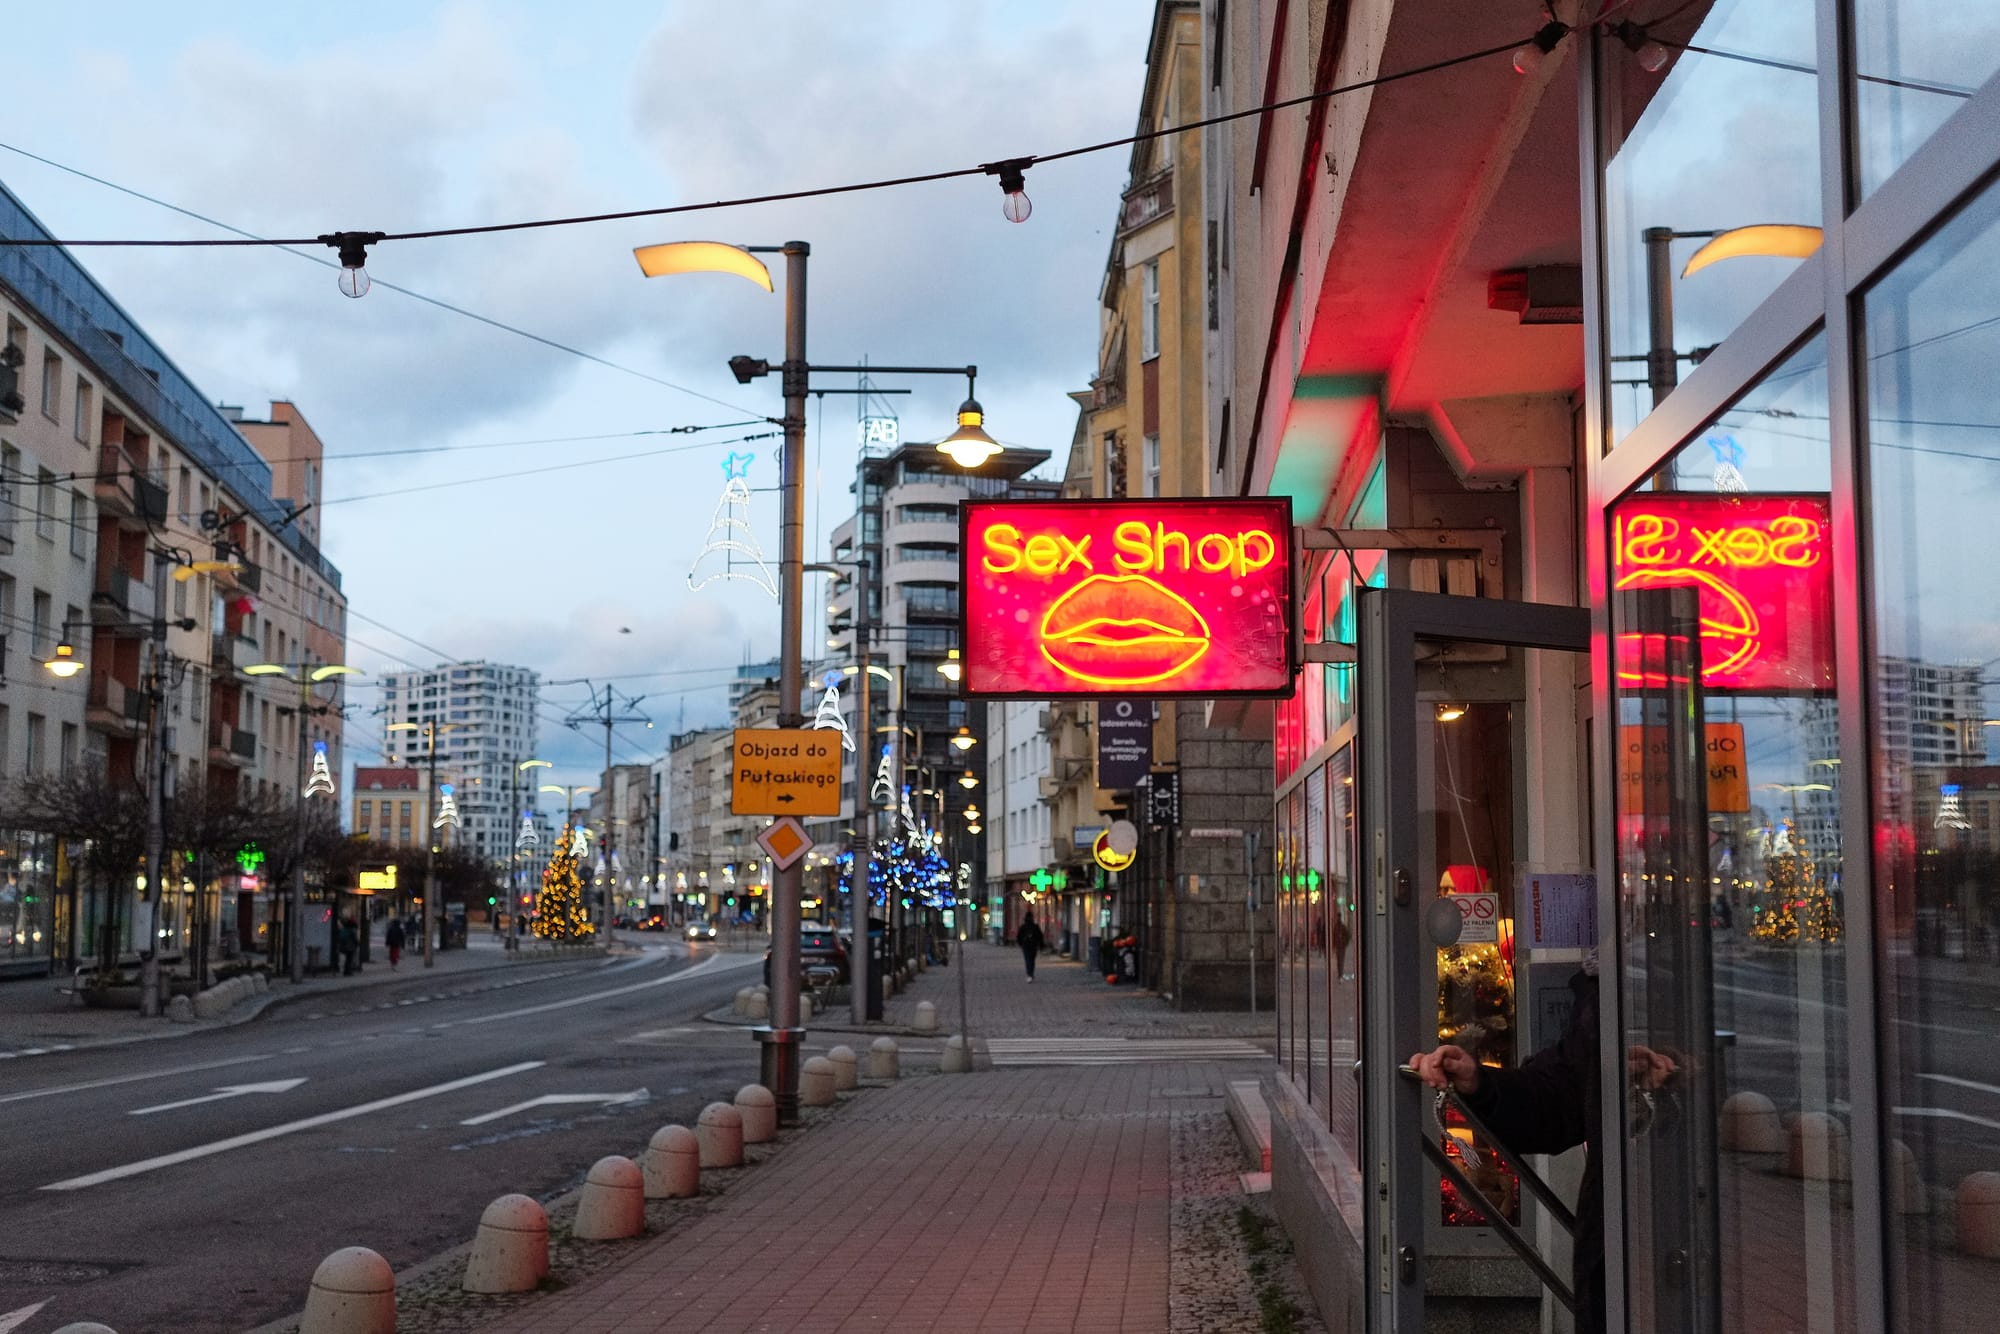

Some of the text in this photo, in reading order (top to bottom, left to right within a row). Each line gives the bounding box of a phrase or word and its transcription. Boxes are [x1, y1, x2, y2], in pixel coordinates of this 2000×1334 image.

[983, 521, 1275, 577] Sex Shop
[740, 743, 828, 761] Objazd do
[740, 769, 837, 789] Pułaskiego
